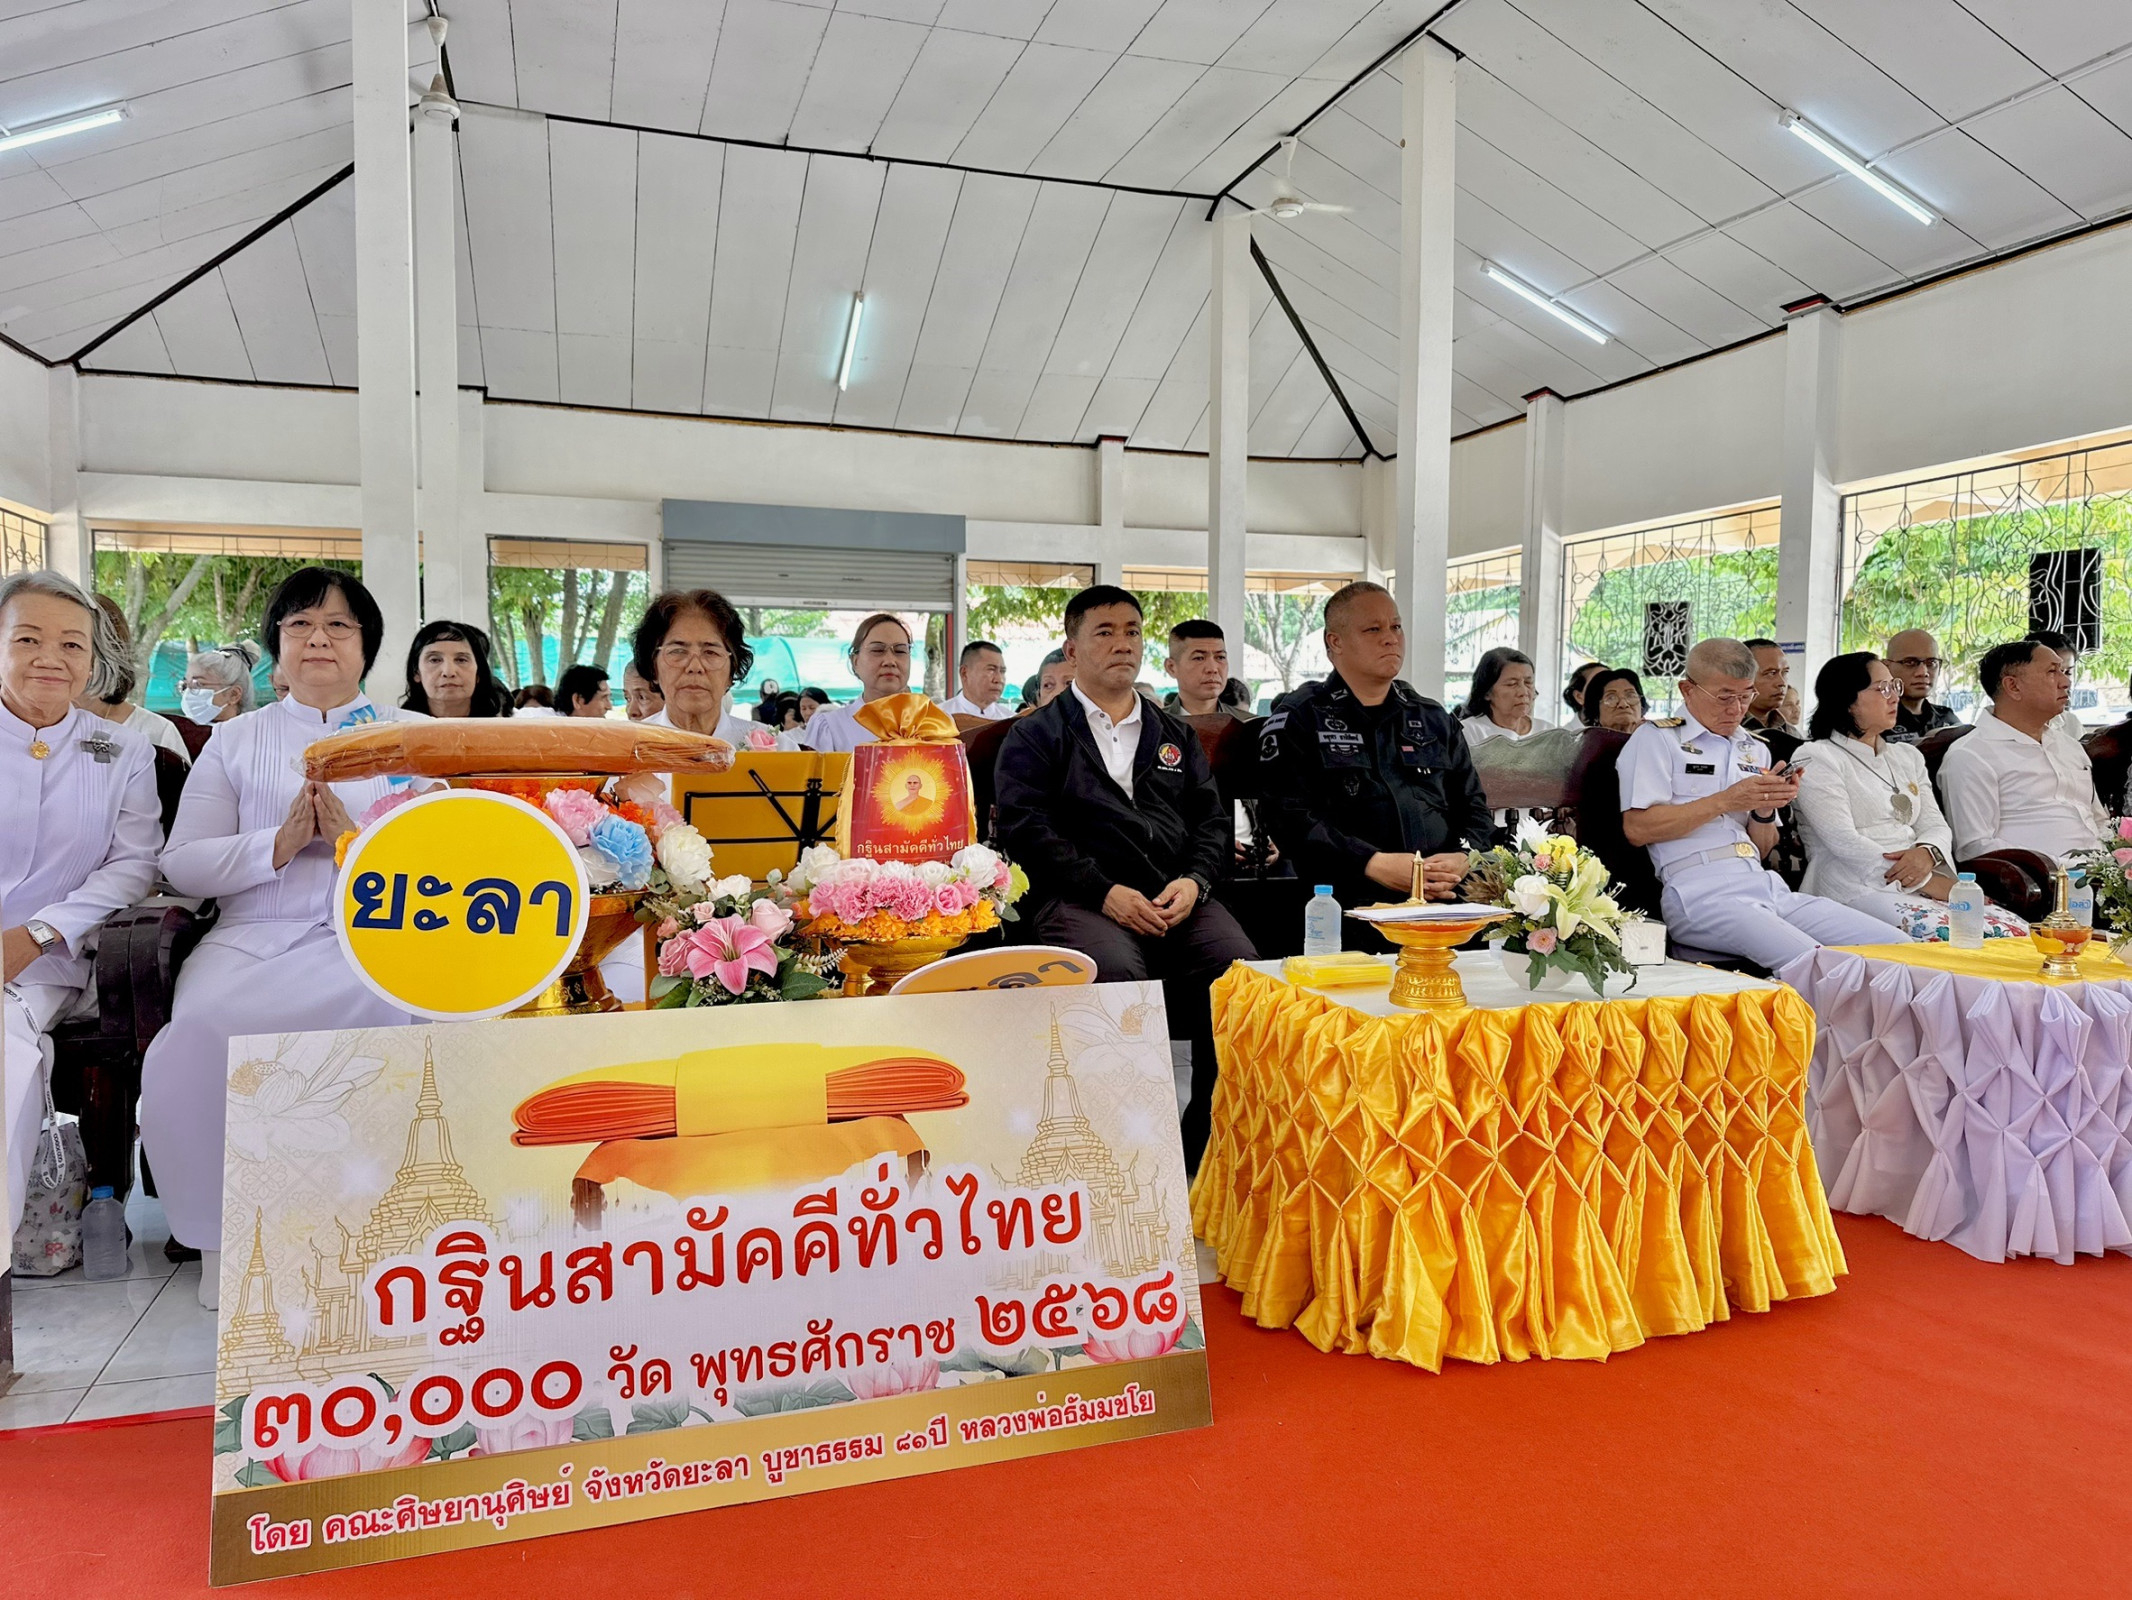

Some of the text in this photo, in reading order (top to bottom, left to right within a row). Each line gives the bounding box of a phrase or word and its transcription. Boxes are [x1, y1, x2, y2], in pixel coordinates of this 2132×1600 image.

[353, 872, 571, 936] ยะลา
[374, 1163, 1083, 1346] กฐินสามัคคีทั่วไทย
[254, 1271, 1178, 1448] ๓๐,๐๐๐ วัด พุทธศักราช ๒๕๖๘
[250, 1385, 1153, 1551] โดย คณะศิษยานุศิษย์ จังหวัดยะลา บูชาธรรม ๘๑ปี หลวงพ่อธัมมชโย
